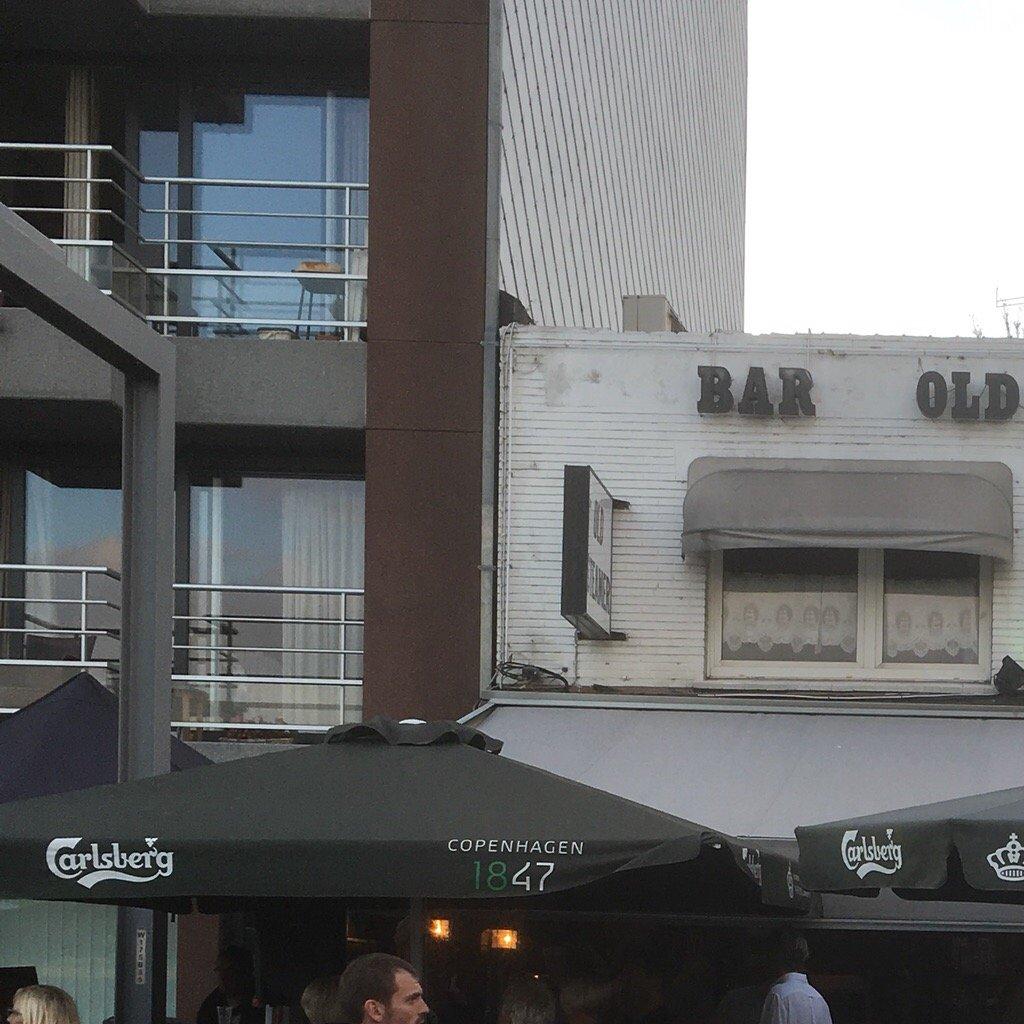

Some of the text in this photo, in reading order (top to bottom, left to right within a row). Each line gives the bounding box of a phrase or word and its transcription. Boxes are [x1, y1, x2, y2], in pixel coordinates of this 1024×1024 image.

[697, 365, 817, 418] BAR
[916, 371, 1020, 420] OLD
[45, 837, 174, 889] Carlsberg
[448, 838, 584, 855] COPENHAGEN
[841, 828, 903, 879] Carlsberg
[473, 860, 555, 892] 1847
